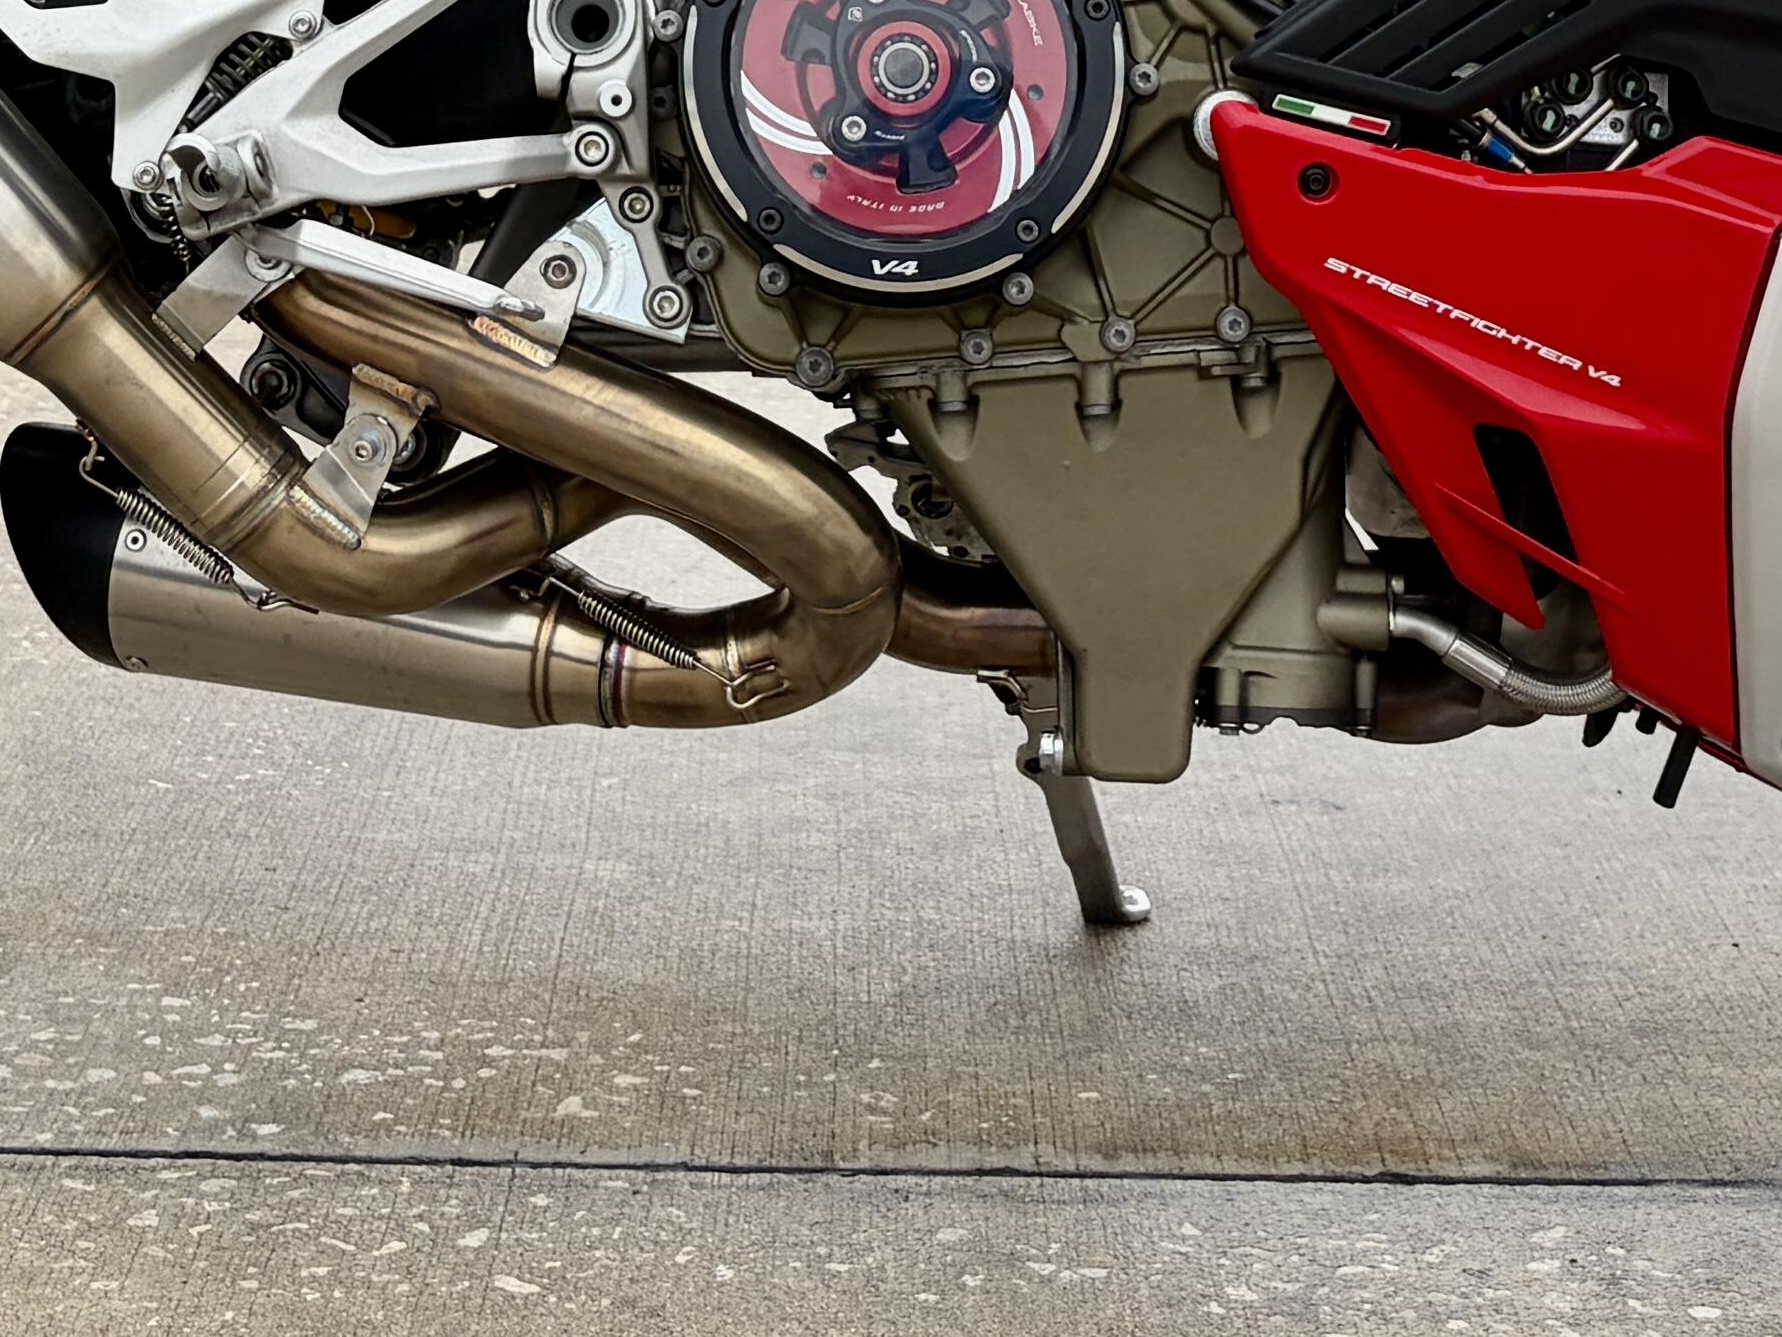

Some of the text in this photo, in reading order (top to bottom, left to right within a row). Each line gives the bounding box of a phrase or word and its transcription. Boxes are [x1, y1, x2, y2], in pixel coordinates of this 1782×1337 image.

[871, 259, 919, 276] V4
[1324, 257, 1622, 387] STREETFIGHTER V4
